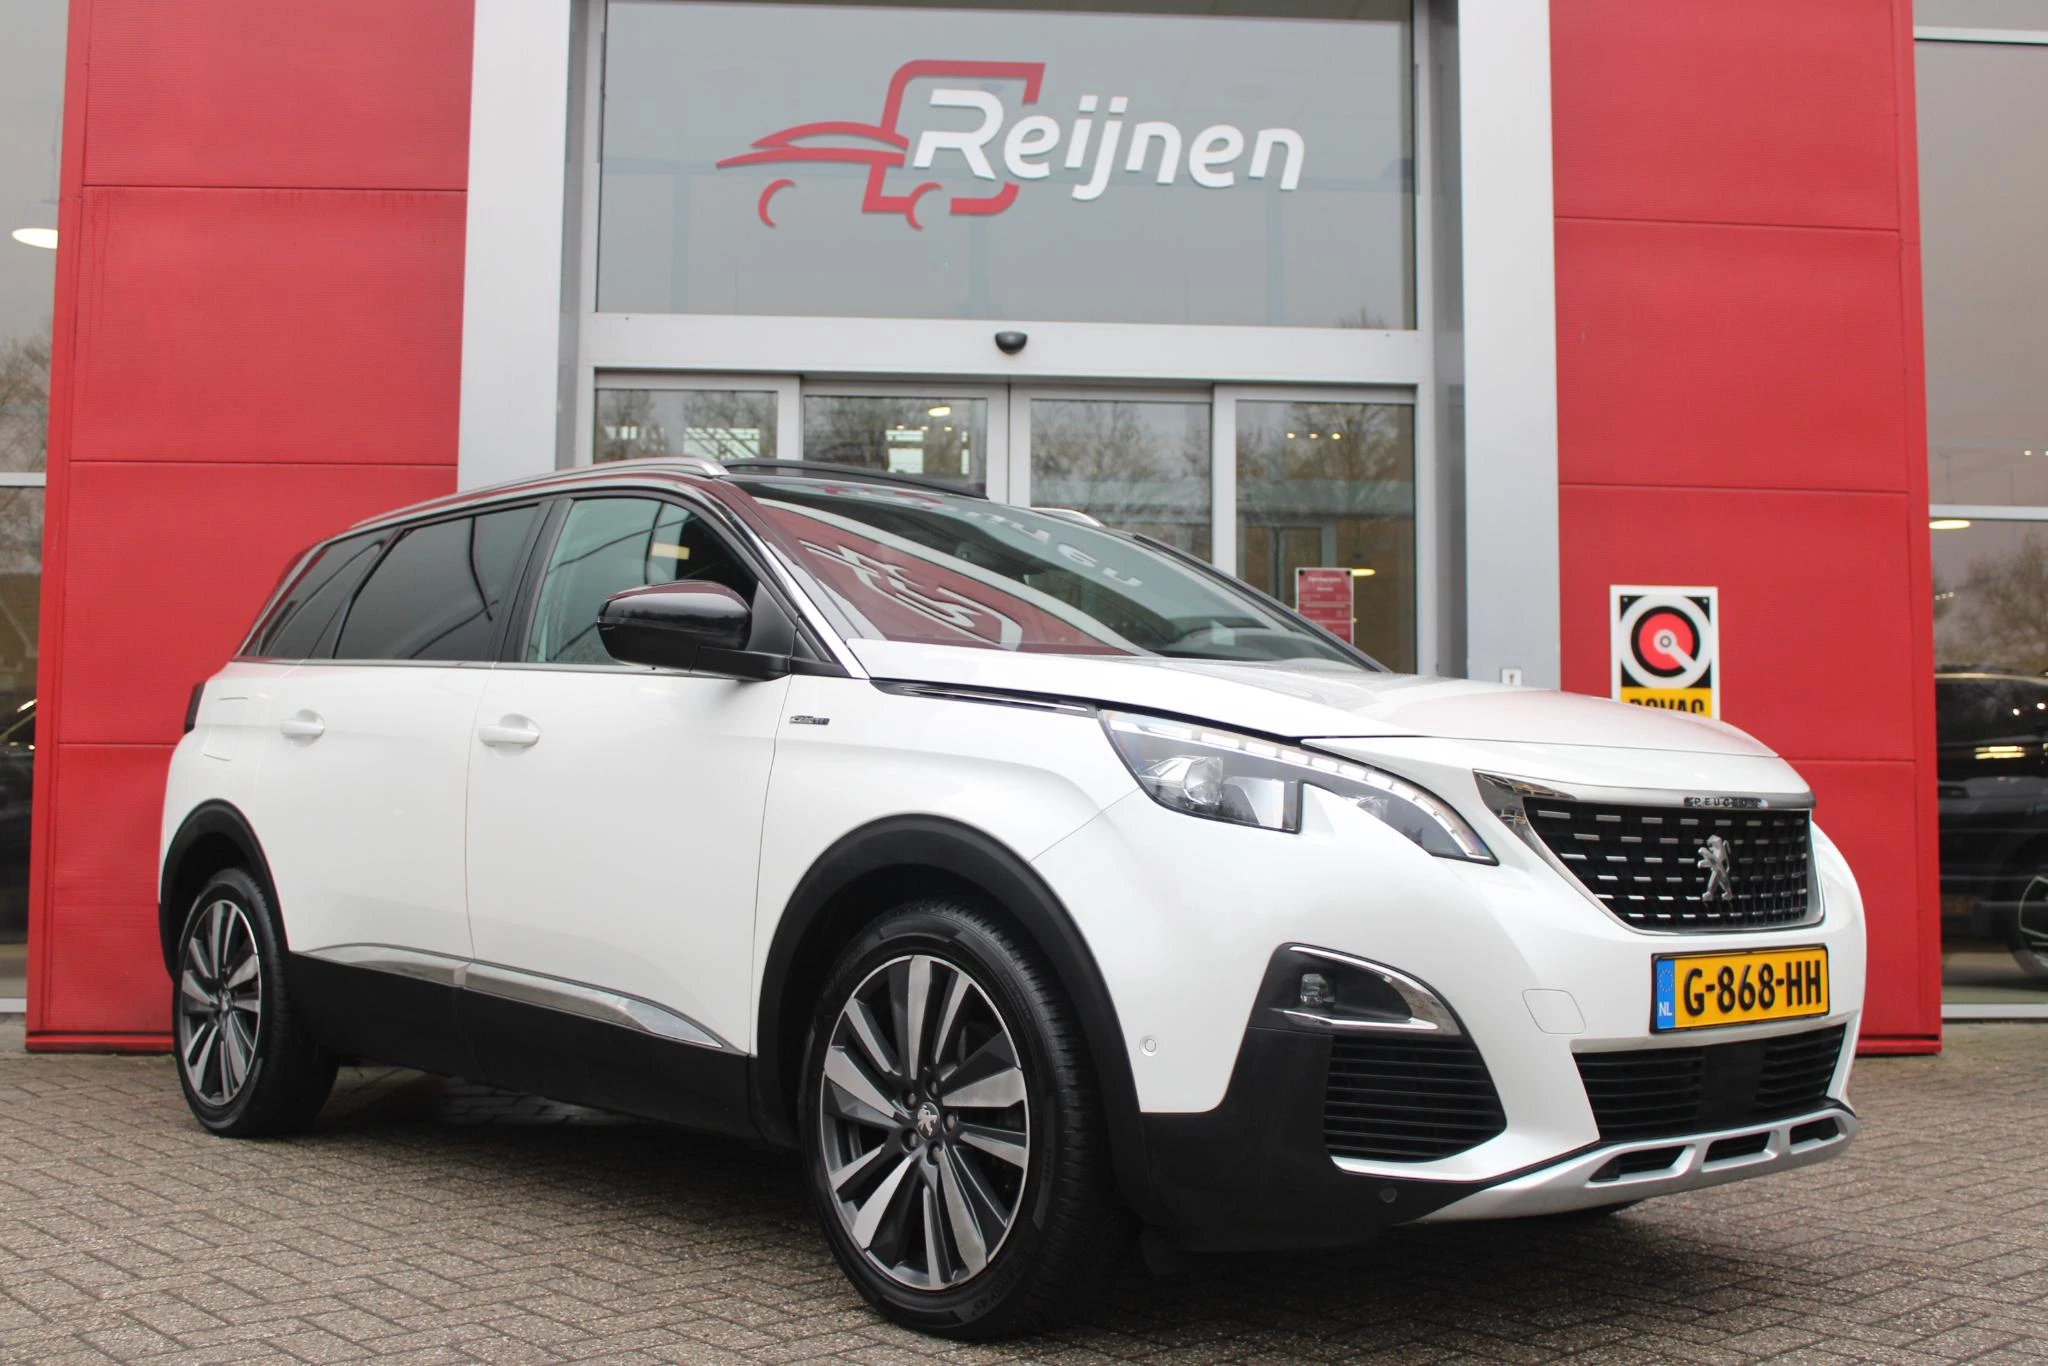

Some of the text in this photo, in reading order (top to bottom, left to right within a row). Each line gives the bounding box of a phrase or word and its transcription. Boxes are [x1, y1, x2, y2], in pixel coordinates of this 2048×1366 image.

[913, 88, 1306, 201] Reijnen
[1658, 1001, 1673, 1017] NL
[1684, 959, 1822, 1017] G-868-HH
